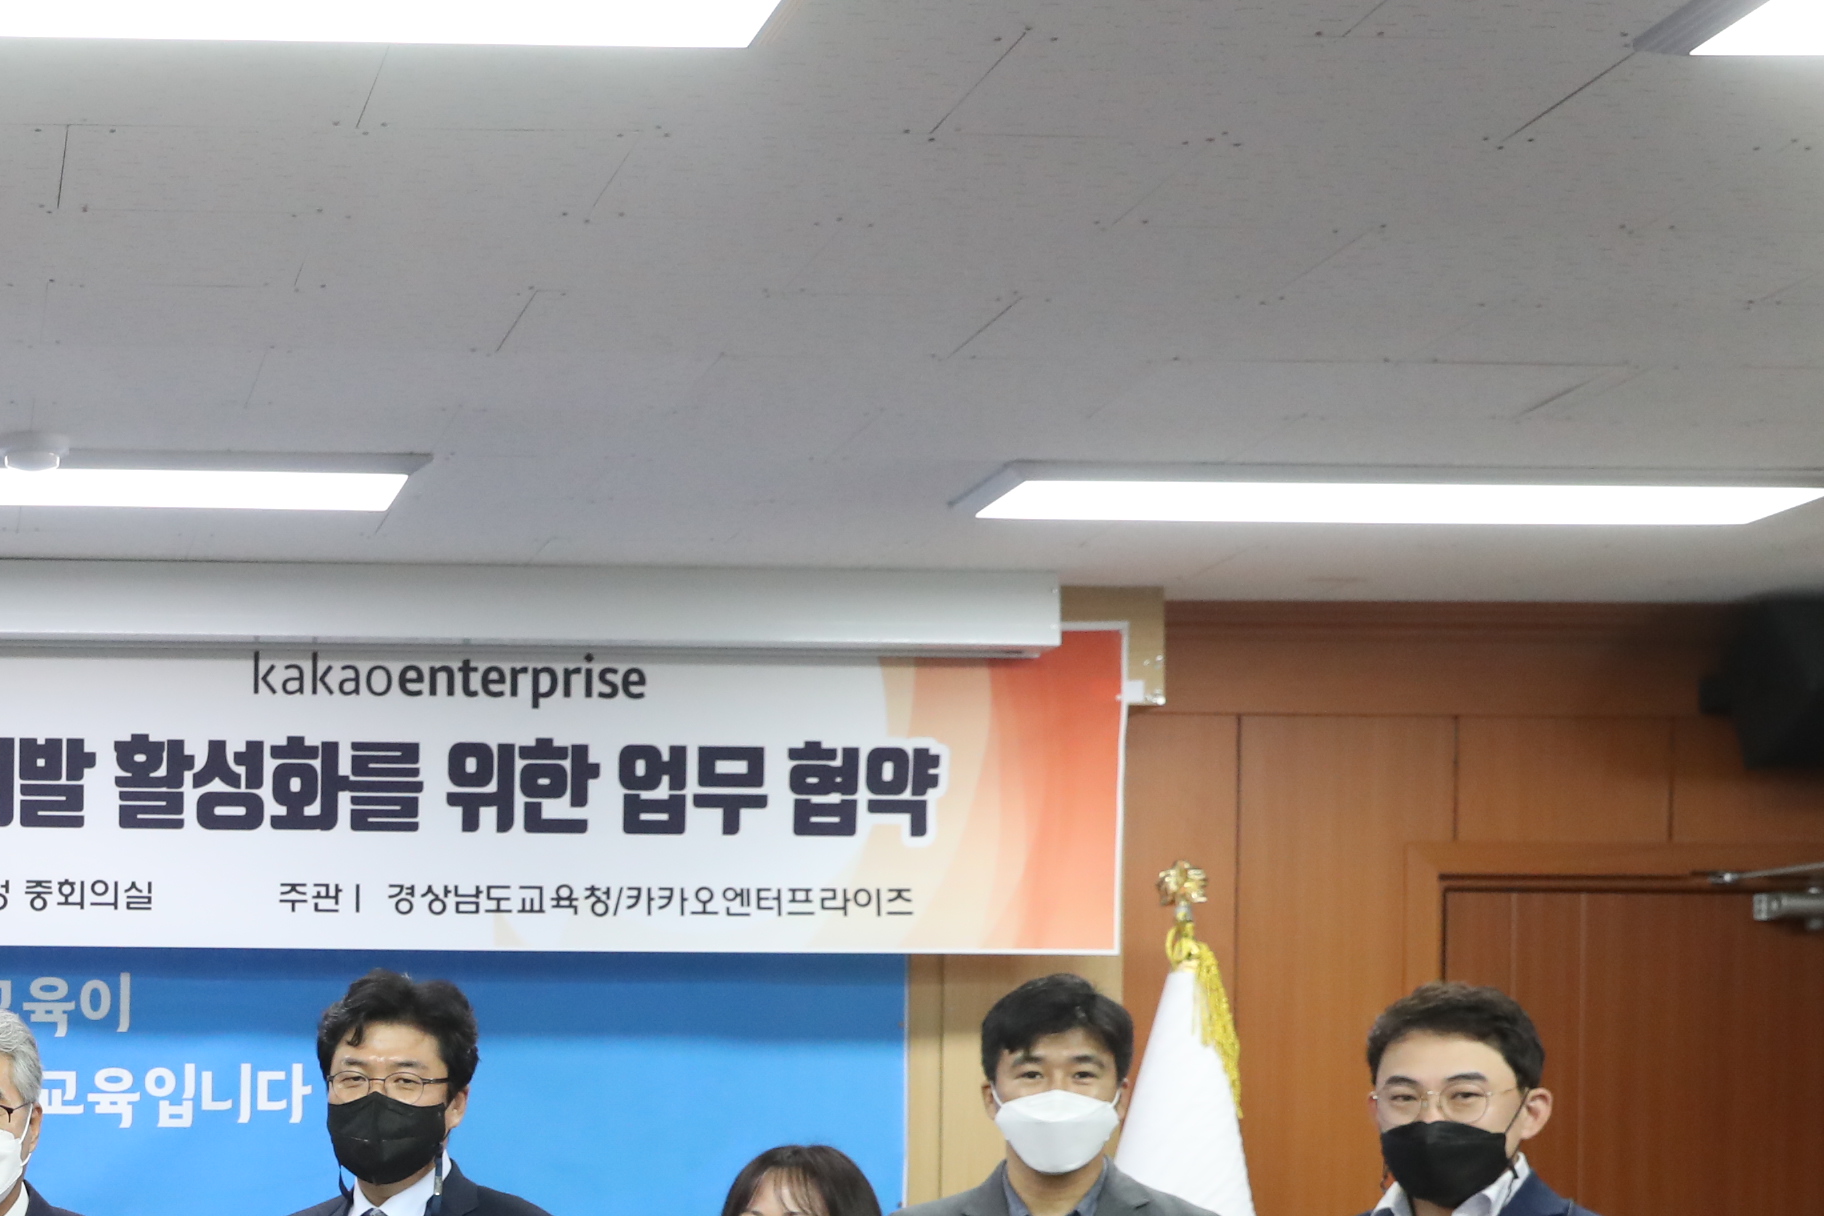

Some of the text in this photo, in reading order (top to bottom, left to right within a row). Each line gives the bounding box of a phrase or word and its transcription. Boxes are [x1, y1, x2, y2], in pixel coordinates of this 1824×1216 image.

[253, 650, 647, 709] kakaoenterprise
[113, 733, 424, 832] 활성화를
[446, 737, 601, 834] 위한
[618, 744, 768, 836] 업무
[788, 740, 940, 837] 협약
[24, 878, 152, 912] 중회의실
[388, 884, 913, 918] 경상남도교육청/카카오엔터프라이즈
